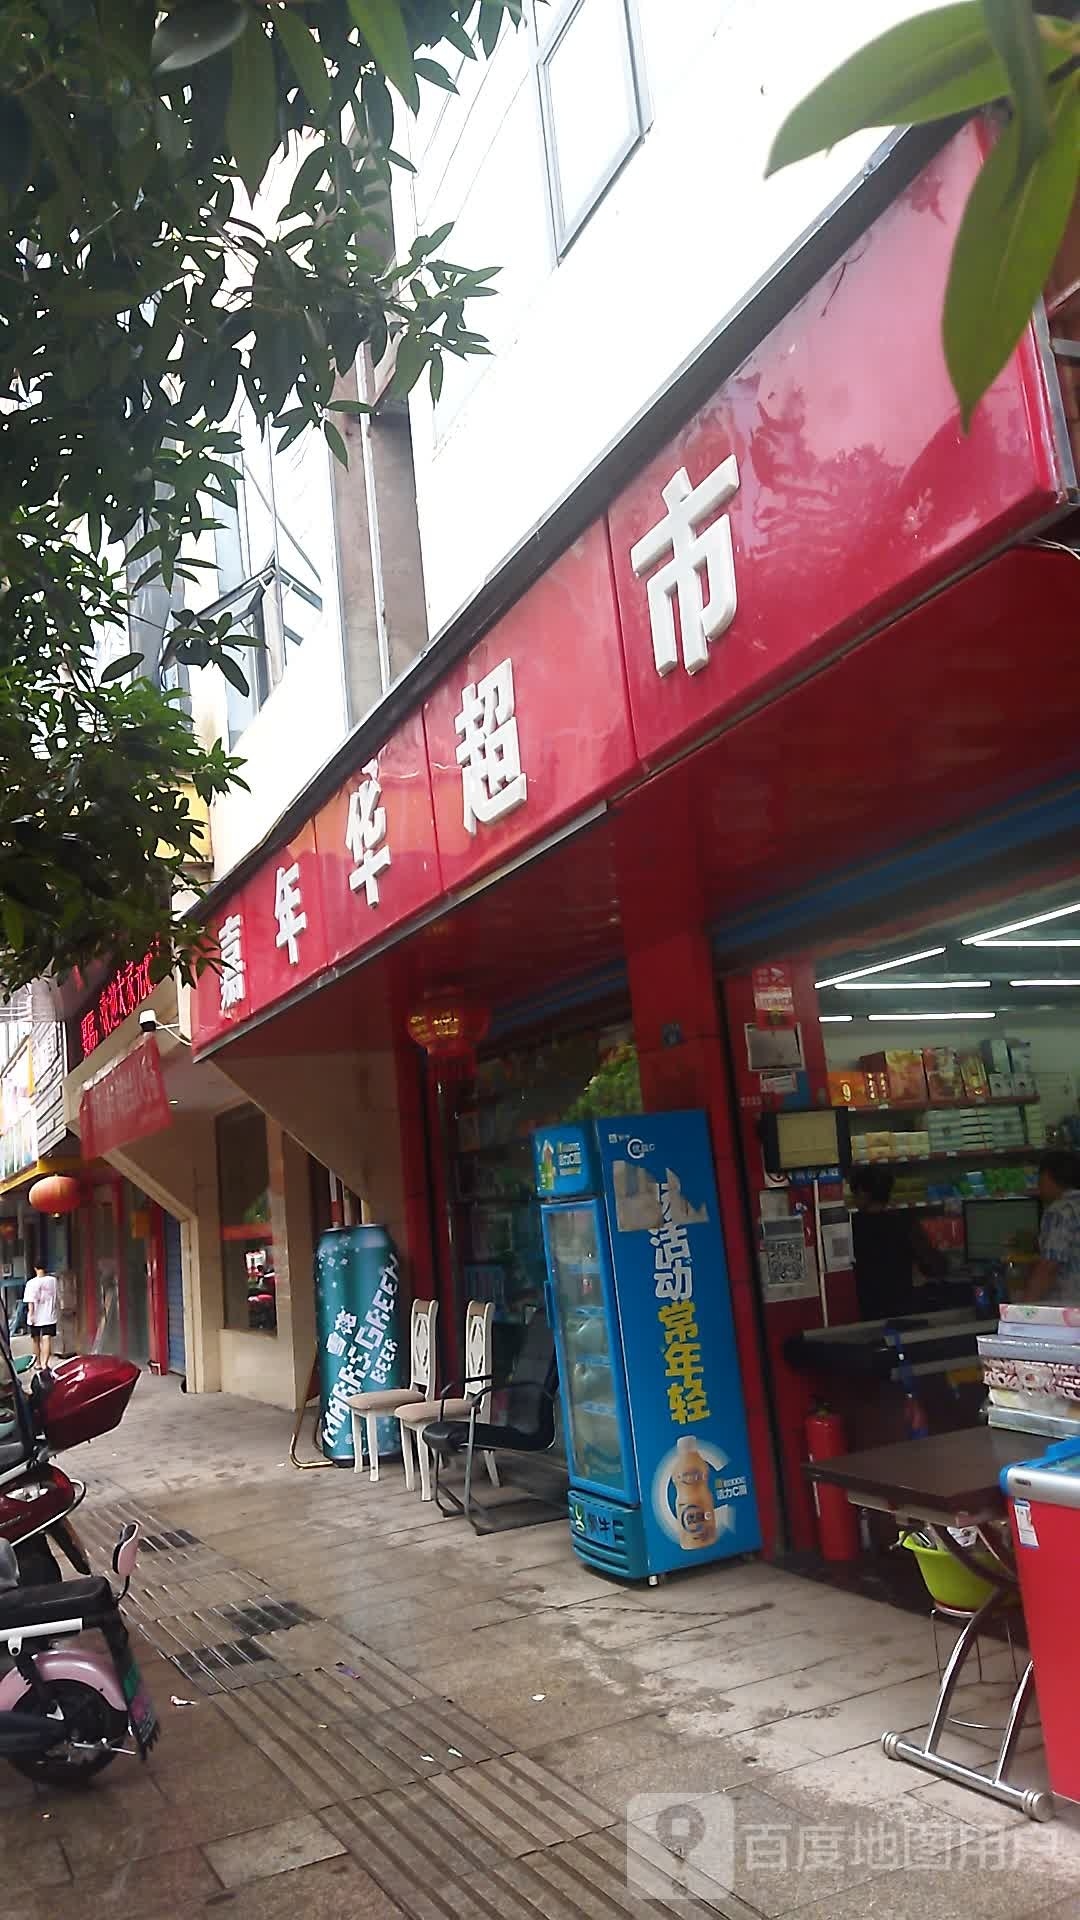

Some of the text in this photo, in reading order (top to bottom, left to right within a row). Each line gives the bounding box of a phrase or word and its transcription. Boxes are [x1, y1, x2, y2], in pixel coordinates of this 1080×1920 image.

[217, 454, 740, 1013] 嘉年华超市
[369, 1338, 399, 1385] BEER
